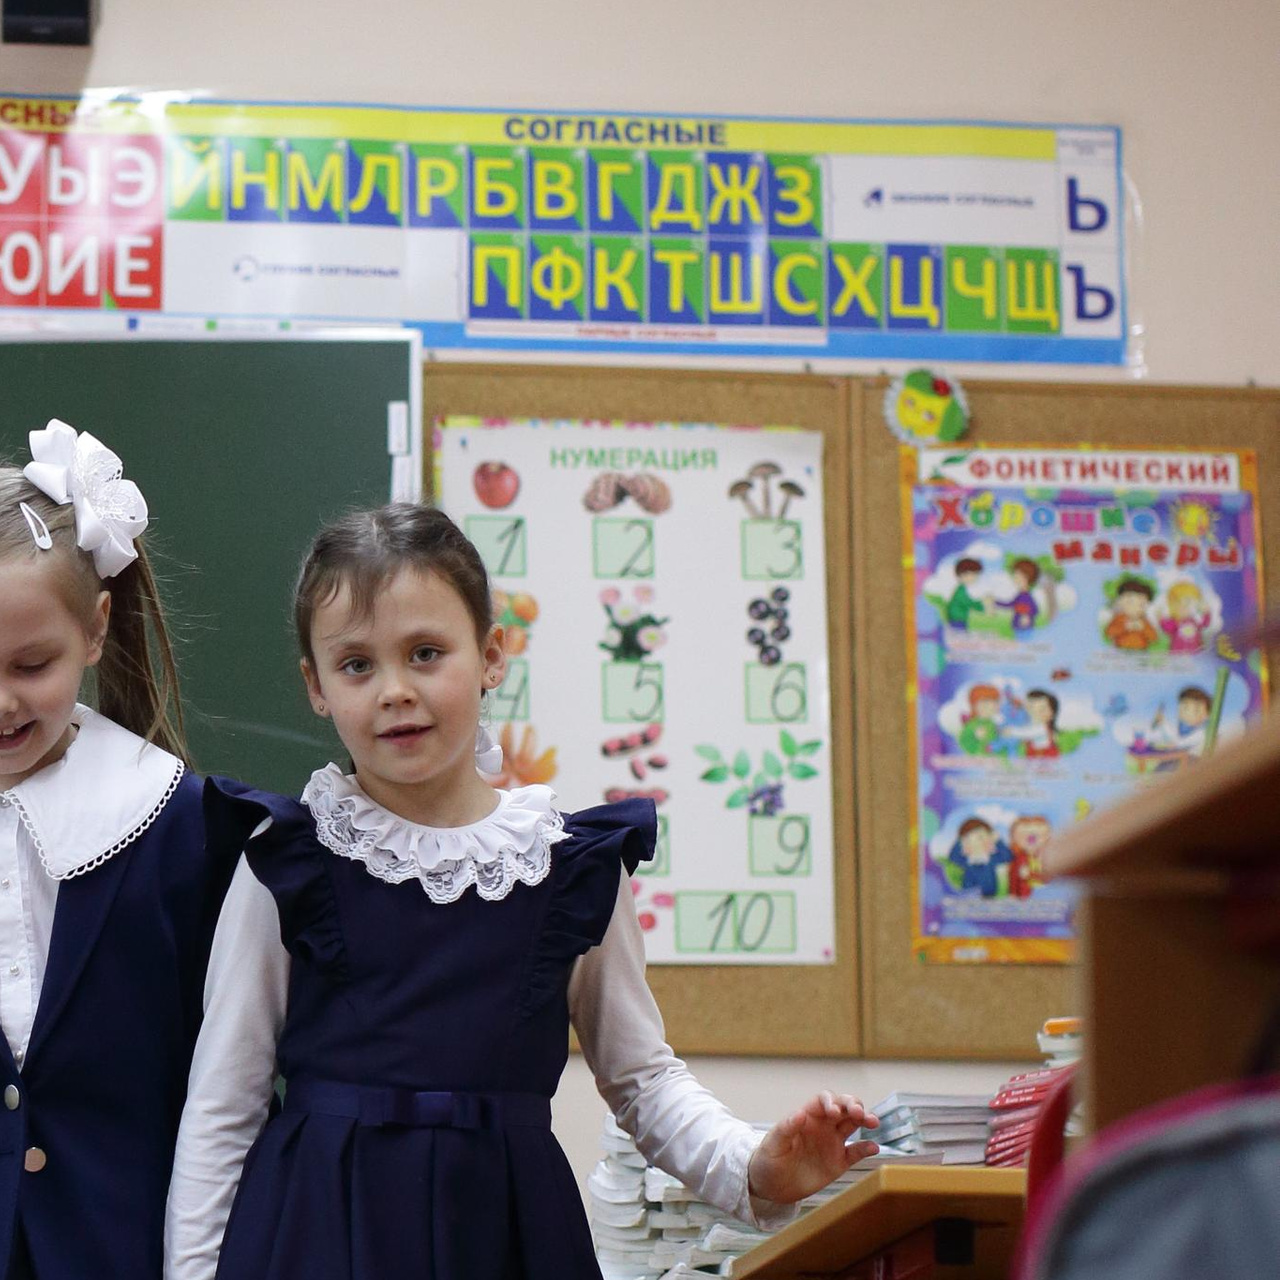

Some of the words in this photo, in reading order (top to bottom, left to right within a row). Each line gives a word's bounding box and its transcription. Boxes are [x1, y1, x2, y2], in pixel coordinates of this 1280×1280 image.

[505, 118, 726, 145] СОГЛАСНЫЕ
[1066, 177, 1108, 232] Ь
[1066, 264, 1115, 320] Ъ
[550, 447, 719, 472] НУМЕРАЦИЯ
[969, 456, 1230, 483] ФОНЕТИЧЕСКИЙ
[496, 518, 525, 575] 1
[619, 520, 652, 577] 2
[767, 522, 803, 579] 3
[630, 664, 664, 721] 5
[770, 663, 808, 721] 6
[774, 816, 810, 874] 9
[707, 893, 775, 952] 10
